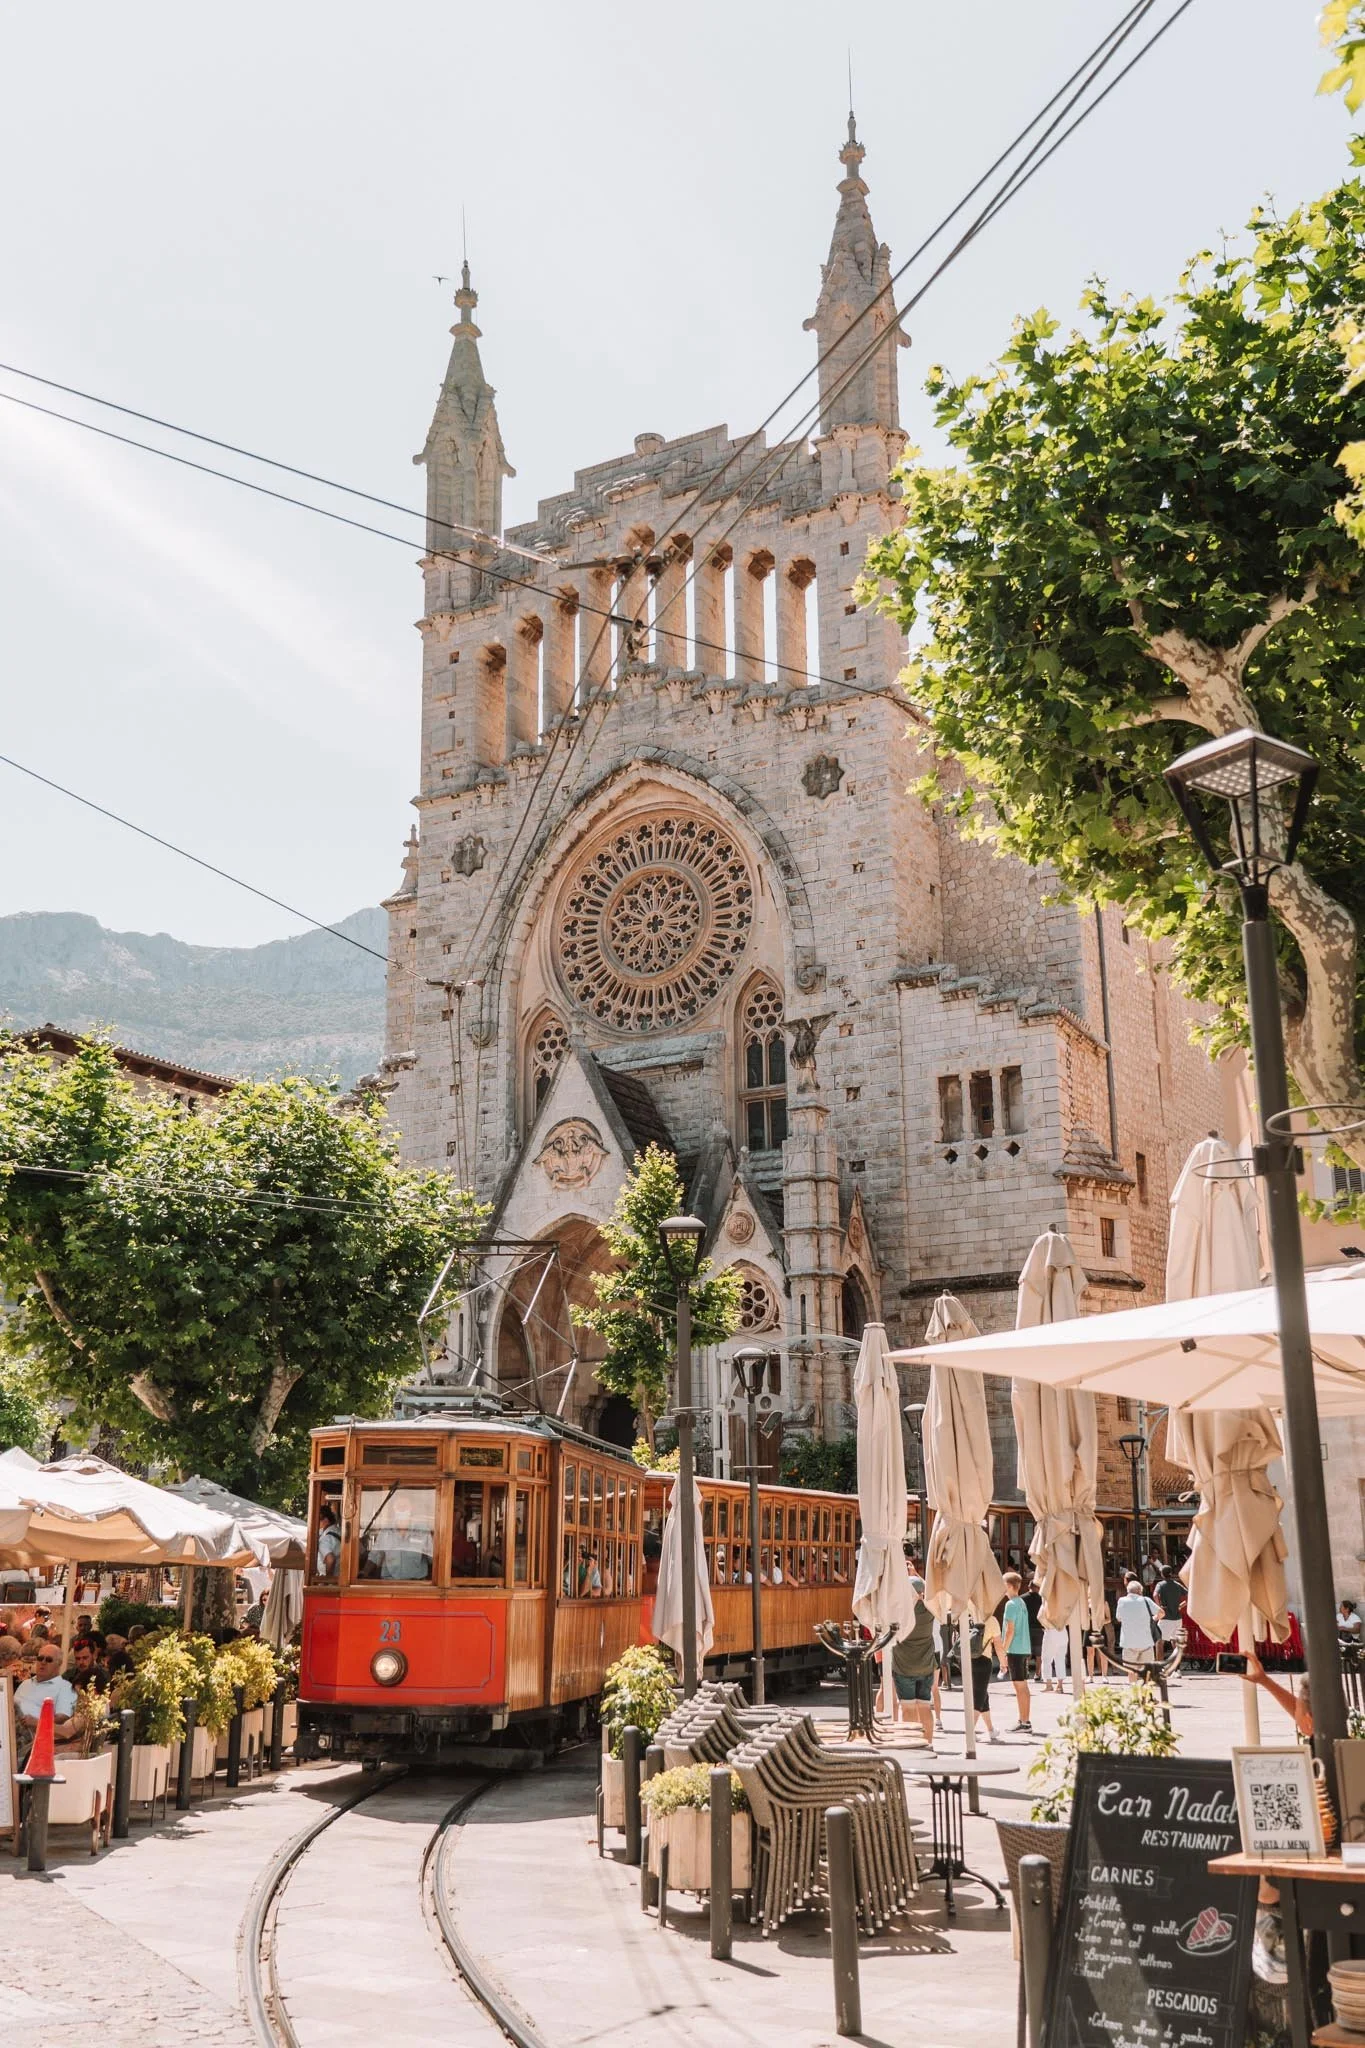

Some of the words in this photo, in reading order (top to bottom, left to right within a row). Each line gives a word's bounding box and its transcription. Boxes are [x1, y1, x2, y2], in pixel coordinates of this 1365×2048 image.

[379, 1620, 401, 1643] 23
[1164, 1786, 1238, 1824] Nadal
[1141, 1829, 1234, 1851] RESTAURANT
[1253, 1839, 1279, 1850] CARTA
[1091, 1866, 1155, 1886] CARNES
[1093, 1912, 1126, 1936] Conejo
[1146, 1988, 1218, 2015] PESCADOS
